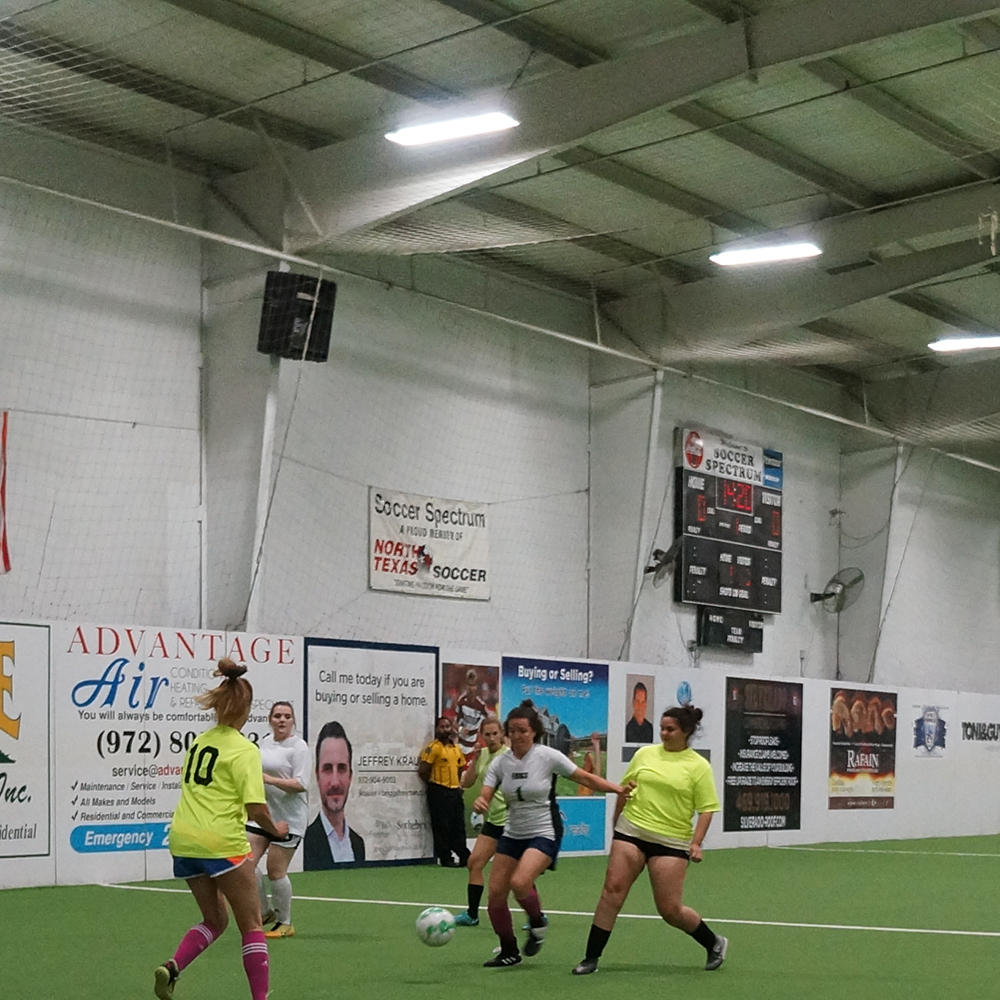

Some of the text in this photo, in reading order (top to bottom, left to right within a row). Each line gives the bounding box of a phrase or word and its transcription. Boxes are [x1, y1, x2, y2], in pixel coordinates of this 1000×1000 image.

[714, 448, 754, 467] SOCCER
[705, 459, 761, 482] SPECTRUM
[375, 493, 486, 528] Soccer Spectrum
[374, 539, 421, 558] NORTH
[374, 556, 419, 575] TEXAS
[432, 565, 486, 582] SOCCER
[67, 625, 296, 665] ADVANTAGE
[71, 657, 169, 710] Air
[319, 670, 425, 689] Call me today if you are
[518, 665, 594, 684] Buying or Selling?
[315, 689, 428, 707] buying or selling a home.
[78, 709, 96, 720] You
[99, 710, 115, 720] will
[118, 710, 150, 723] always
[153, 712, 164, 721] be
[961, 722, 1000, 741] TONI&GU
[96, 730, 161, 759] (972)
[183, 743, 219, 787] 10
[358, 756, 394, 767] JEFFREY
[80, 782, 125, 791] Maintenance
[131, 781, 156, 790] Service
[80, 796, 156, 806] All Makes and Models
[81, 810, 174, 821] Residential and Commercia
[85, 830, 154, 848] Emergency
